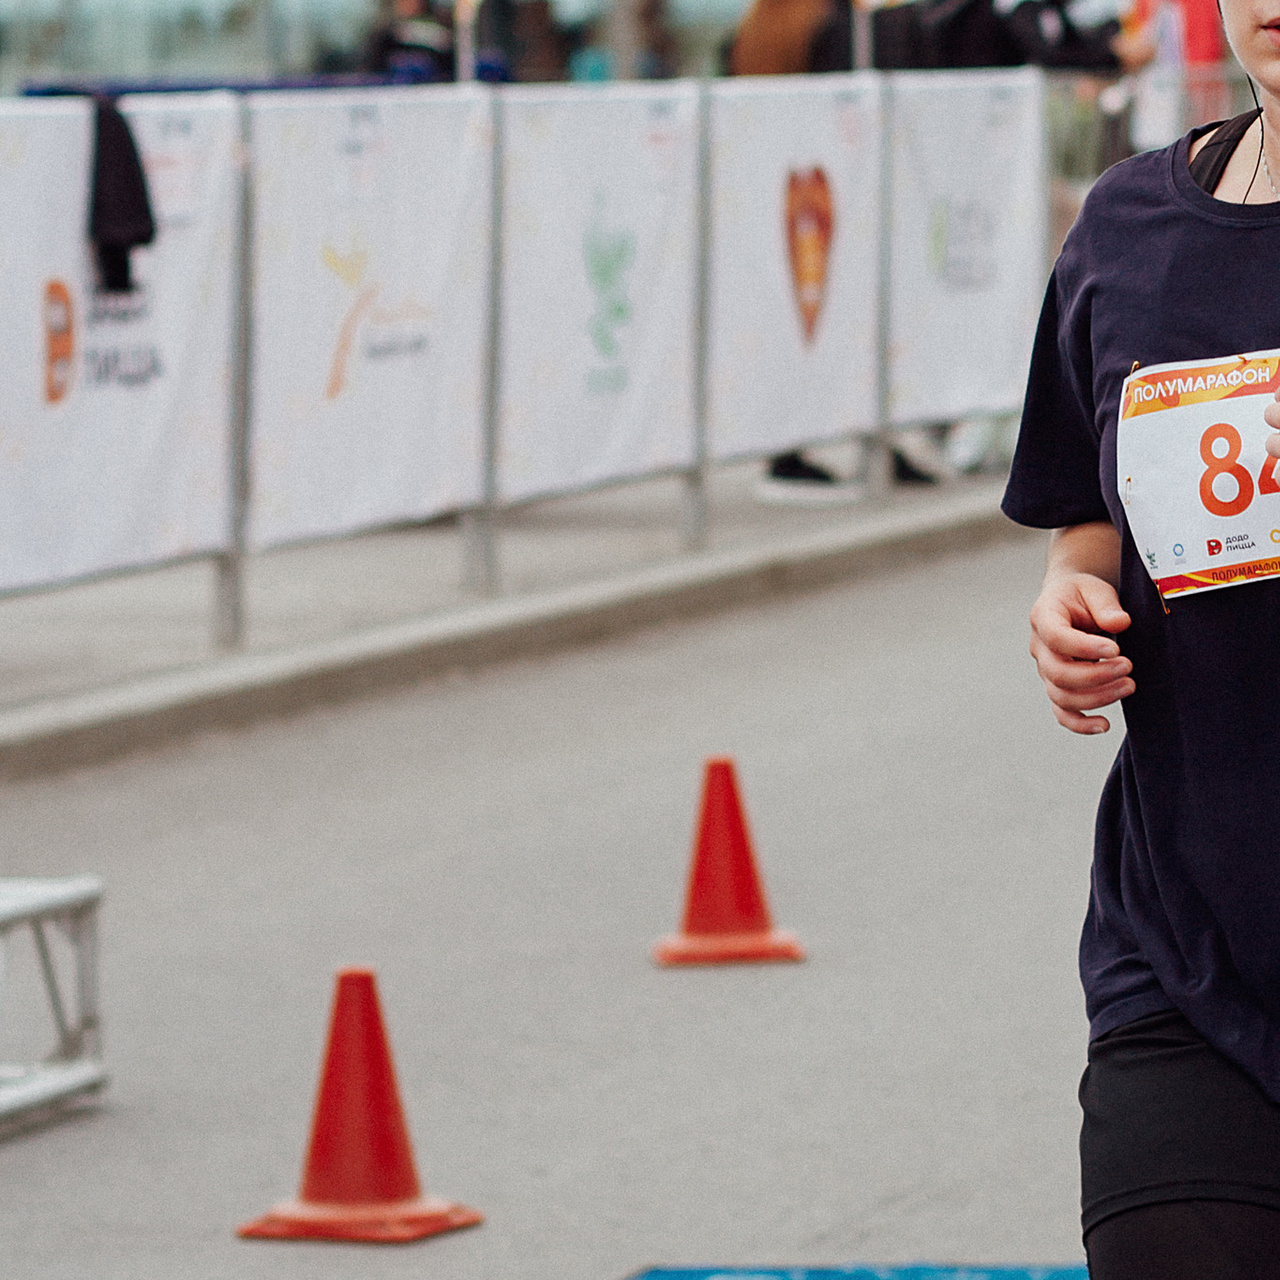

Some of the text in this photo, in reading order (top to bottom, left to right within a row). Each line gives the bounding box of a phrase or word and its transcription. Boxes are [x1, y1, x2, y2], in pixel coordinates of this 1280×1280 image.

[1134, 367, 1270, 404] ПОЛУМАРАФОН
[1225, 534, 1249, 544] ДОДО
[1226, 541, 1256, 552] ПИЦЦА
